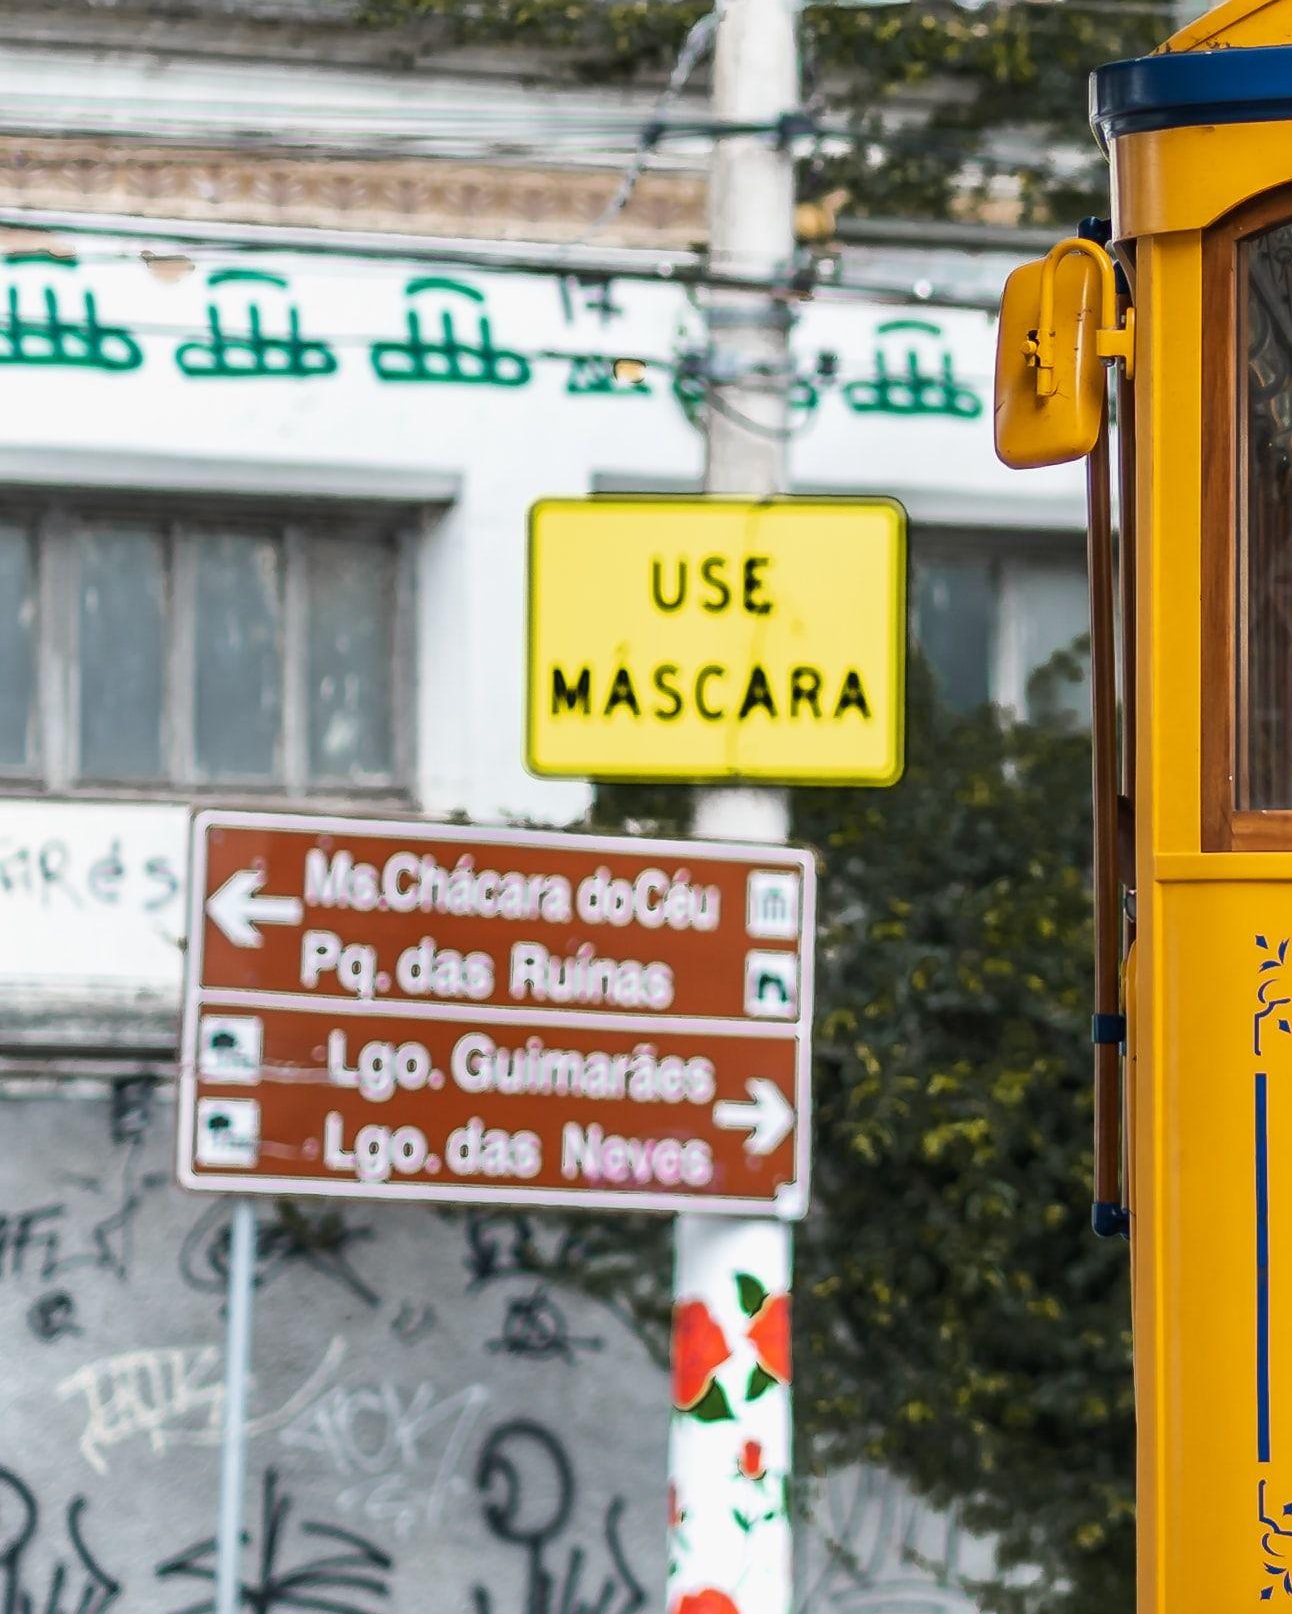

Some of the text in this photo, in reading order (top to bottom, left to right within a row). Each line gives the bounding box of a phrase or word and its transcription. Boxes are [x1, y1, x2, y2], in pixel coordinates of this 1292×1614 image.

[652, 556, 773, 615] USE
[551, 641, 873, 722] MÁSCARA
[302, 930, 675, 1011] Pq. das Ruínas
[328, 1028, 717, 1105] Lgo. Guimarães
[324, 1110, 714, 1186] Lgo. das Neves
